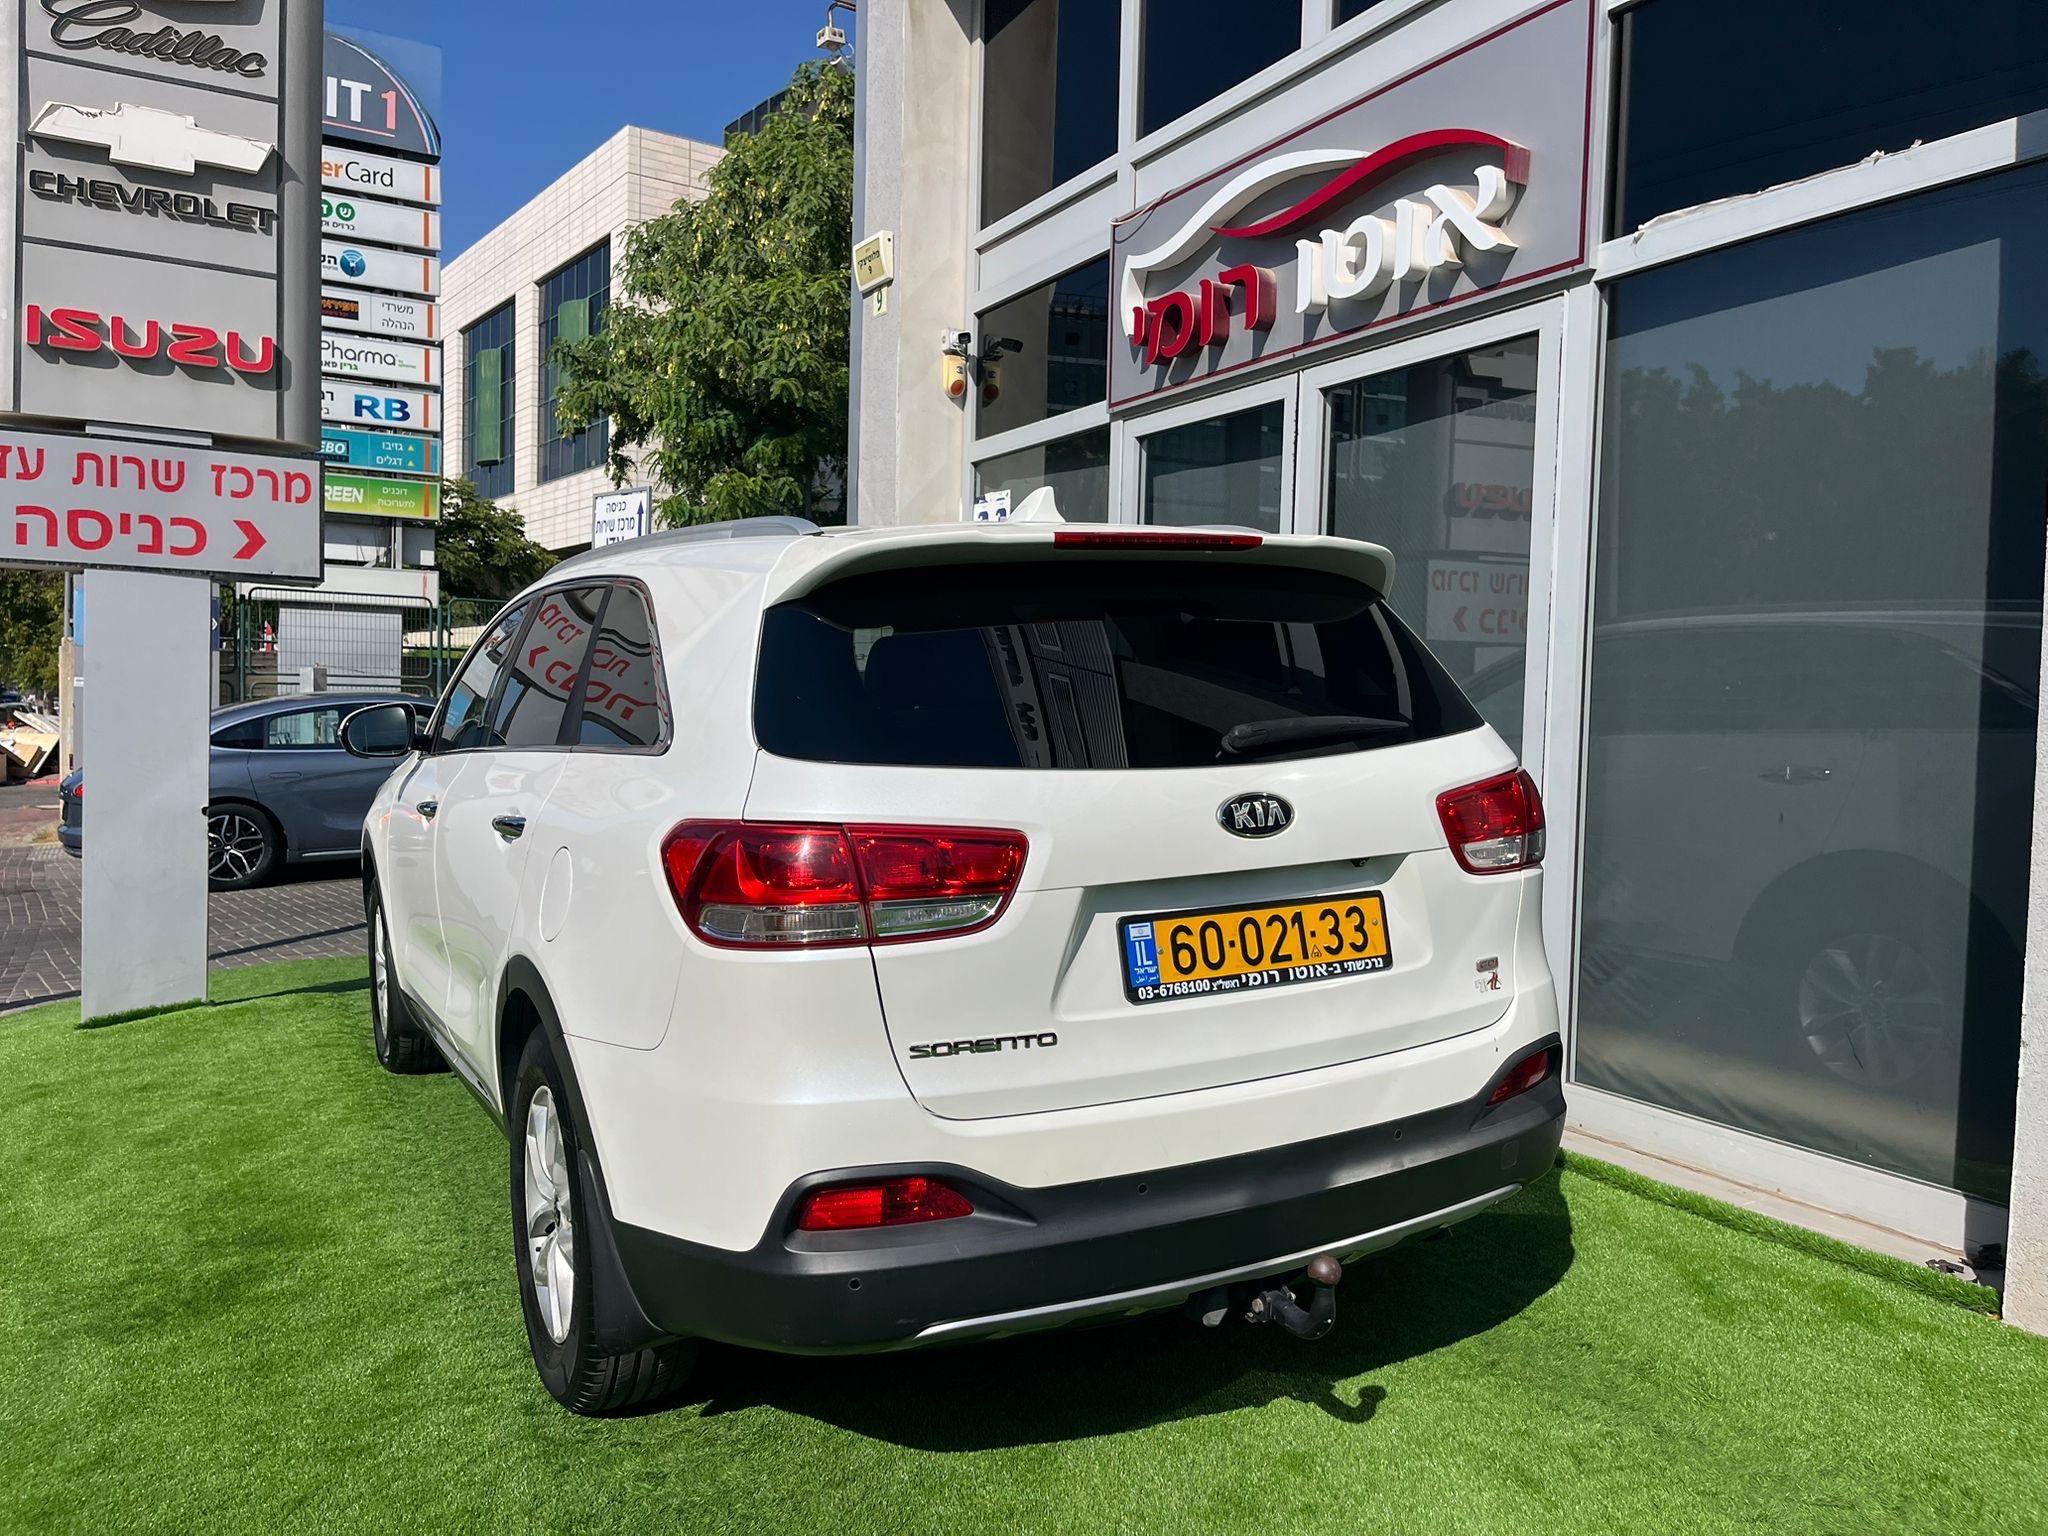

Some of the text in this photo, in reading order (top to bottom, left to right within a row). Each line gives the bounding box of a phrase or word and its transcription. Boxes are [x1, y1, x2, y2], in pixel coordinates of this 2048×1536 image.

[40, 0, 268, 78] Cadillac
[326, 76, 397, 130] IT 1
[321, 161, 394, 188] erCard
[29, 168, 279, 233] CHEVROLET
[1133, 165, 1519, 366] אוטו רומי
[381, 302, 414, 315] משרדי
[876, 289, 883, 311] 9
[381, 317, 415, 331] הנהלה
[26, 303, 275, 373] ISUZU
[321, 340, 396, 366] Pharma
[340, 361, 358, 371] גרין
[354, 393, 411, 422] RB
[321, 440, 346, 454] EBO
[382, 441, 404, 452] גזיבו
[71, 451, 186, 493] שרות
[376, 455, 403, 466] דגלים
[210, 463, 312, 504] מרכז
[324, 485, 364, 503] REEN
[606, 501, 627, 514] כניסה
[15, 505, 208, 557] כניסה
[617, 516, 635, 531] מרכז
[1230, 800, 1287, 829] KIA
[1135, 941, 1153, 967] IL
[1344, 957, 1384, 972] נרכשתי
[1134, 966, 1158, 975] ישראל
[1241, 970, 1280, 987] רומי
[1138, 979, 1211, 1000] 03-6768100
[909, 1032, 1058, 1060] SORENTO
